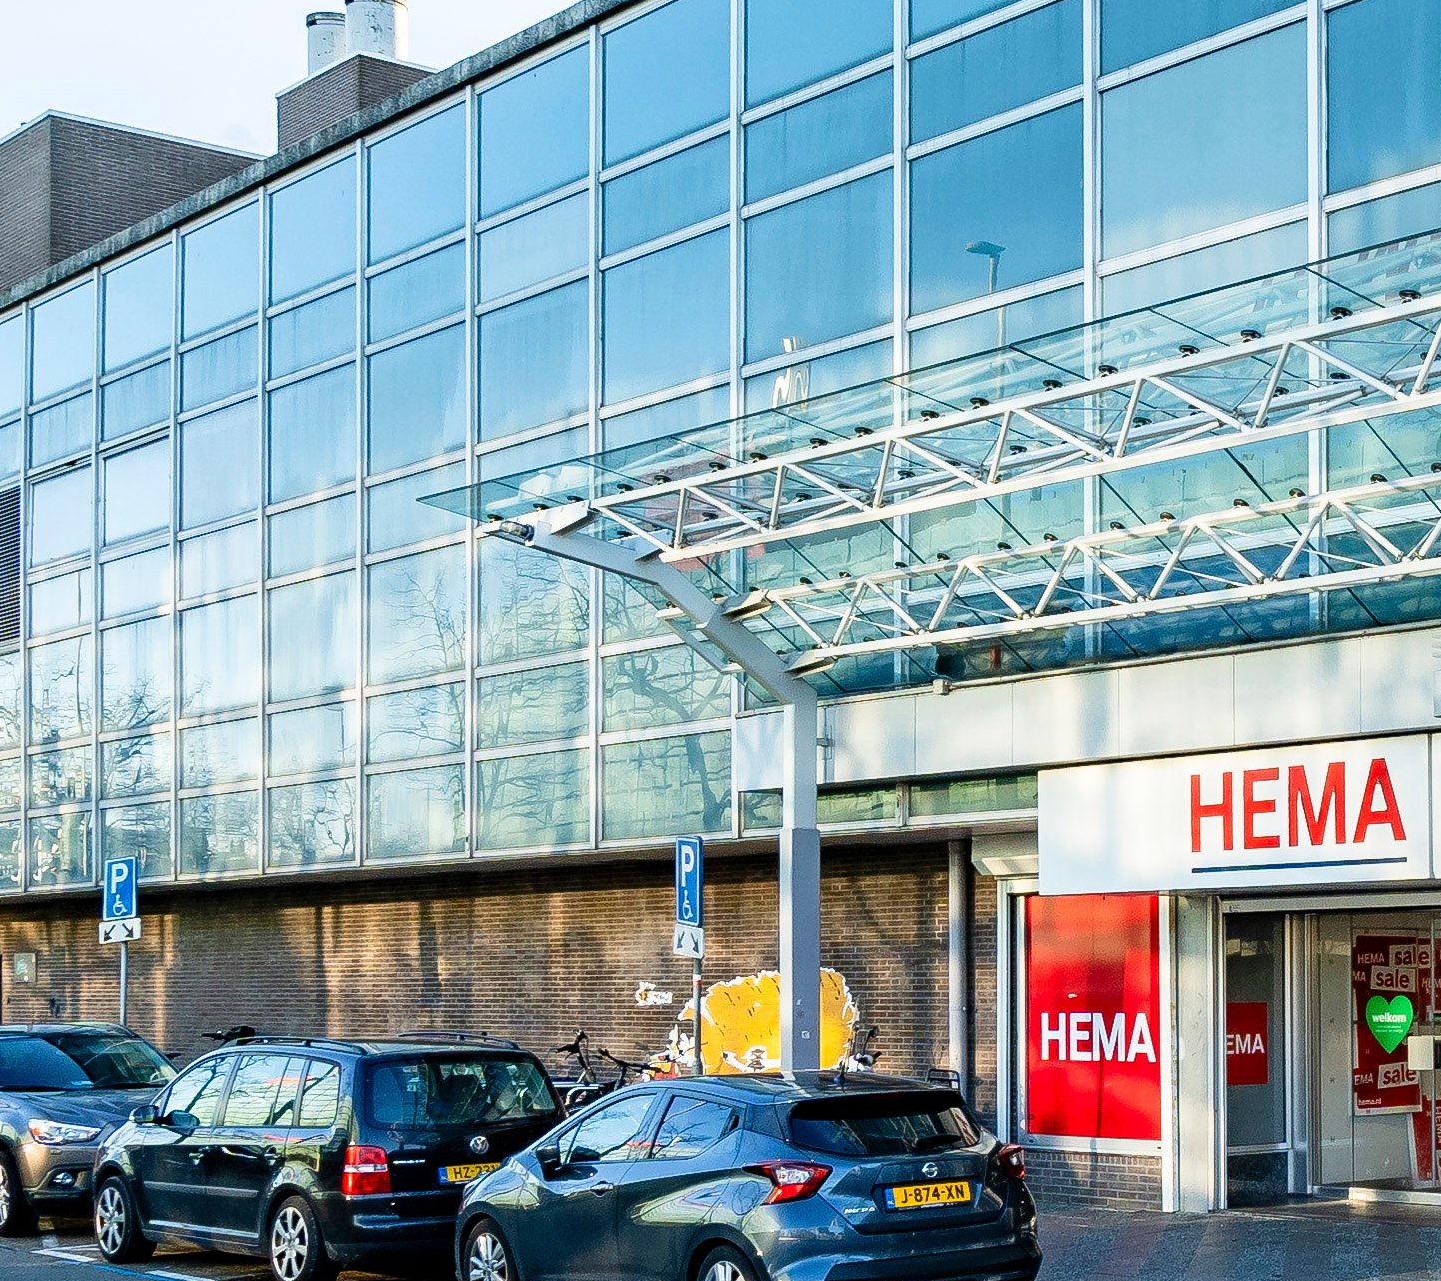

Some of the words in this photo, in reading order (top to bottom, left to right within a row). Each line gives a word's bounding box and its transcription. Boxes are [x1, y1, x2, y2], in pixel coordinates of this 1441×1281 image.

[1191, 757, 1407, 853] HEMA
[681, 845, 695, 888] P
[110, 863, 129, 894] P
[1358, 952, 1385, 965] HEMA
[1394, 946, 1430, 966] sale
[1375, 968, 1410, 989] sale
[1372, 1012, 1407, 1023] welkom
[1041, 1011, 1157, 1063] HEMA
[1226, 1033, 1266, 1055] EMA
[1382, 1063, 1417, 1085] sale
[901, 1184, 965, 1204] J-874-XN
